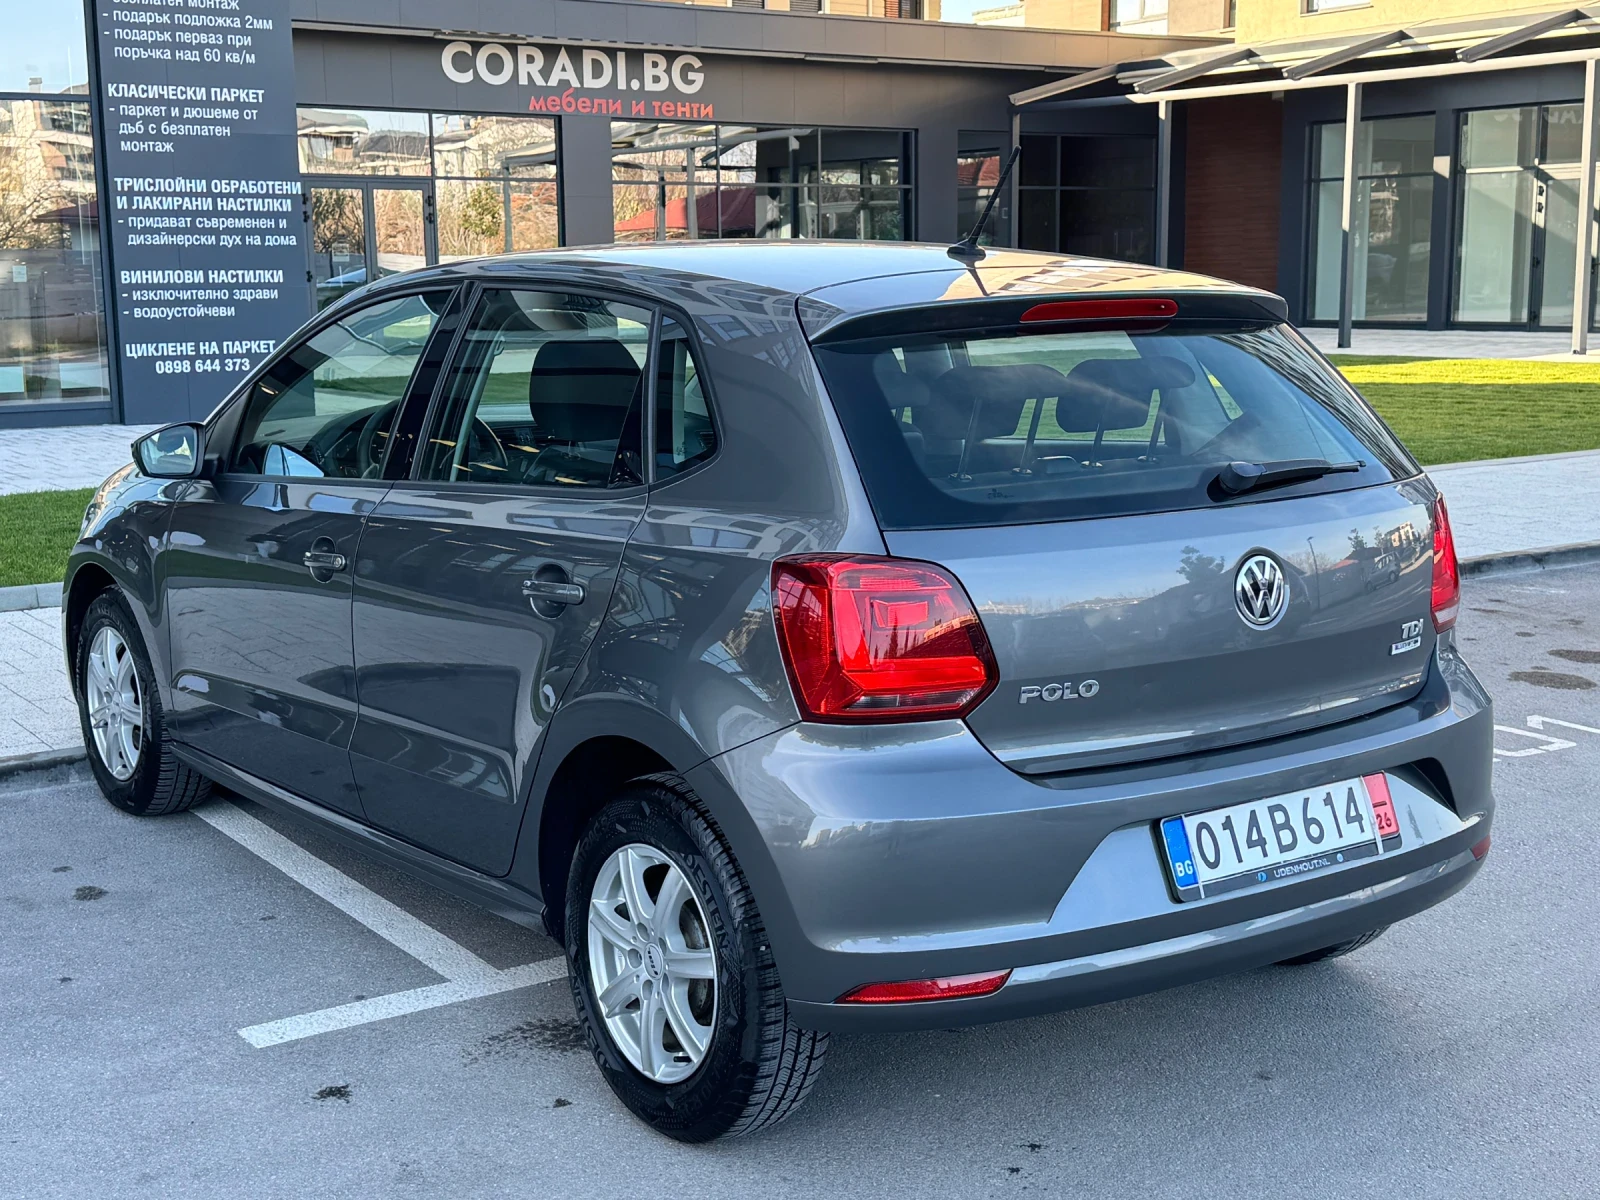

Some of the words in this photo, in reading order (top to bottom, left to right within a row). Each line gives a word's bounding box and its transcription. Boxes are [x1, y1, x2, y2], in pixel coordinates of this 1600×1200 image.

[187, 0, 240, 10] монтаж
[113, 10, 171, 25] подарък
[174, 14, 241, 28] подложка
[245, 15, 273, 30] 2мм
[114, 28, 172, 44] подарък
[176, 31, 223, 46] перваз
[228, 34, 252, 48] при
[114, 46, 171, 61] поръчка
[176, 50, 200, 62] над
[204, 48, 221, 62] 60
[226, 50, 256, 65] кв/м
[441, 41, 705, 95] CORADI.BG
[108, 83, 206, 101] КЛАСИЧЕСКИ
[211, 87, 265, 103] ПАРКЕТ
[120, 104, 167, 120] паркет
[171, 106, 179, 117] и
[184, 106, 240, 120] дюшеме
[244, 108, 258, 120] от
[528, 87, 622, 115] мебели
[632, 100, 646, 117] и
[652, 101, 714, 119] тенти
[119, 120, 144, 135] дъб
[148, 124, 156, 134] с
[161, 121, 231, 137] безплатен
[120, 140, 174, 152] монтаж
[114, 177, 206, 193] ТРИСЛОЙНИ
[211, 179, 302, 195] ОБРАБОТЕНИ
[116, 196, 128, 210] И
[132, 196, 213, 211] ЛАКИРАНИ
[218, 198, 292, 212] НАСТИЛКИ
[128, 216, 192, 229] придават
[196, 217, 275, 230] съвременен
[279, 218, 287, 228] и
[128, 232, 216, 247] дизайнерски
[220, 234, 242, 248] дух
[246, 235, 261, 246] на
[265, 234, 297, 247] дома
[120, 270, 204, 284] ВИНИЛОВИ
[208, 270, 284, 284] НАСТИЛКИ
[132, 289, 229, 300] изключително
[232, 288, 278, 302] здрави
[134, 304, 236, 320] водоустойчеви
[126, 342, 196, 359] ЦИКЛЕНЕ
[200, 341, 219, 355] НА
[223, 340, 276, 354] ПАРКЕТ
[155, 360, 191, 374] 0898
[195, 359, 221, 374] 644
[224, 358, 250, 372] 373
[1402, 618, 1424, 639] TDI
[1018, 679, 1100, 704] POLO
[1195, 787, 1366, 870] 014B614
[1375, 811, 1392, 830] 26
[1175, 860, 1195, 877] BG
[1273, 858, 1331, 878] UDENHOUT.NL
